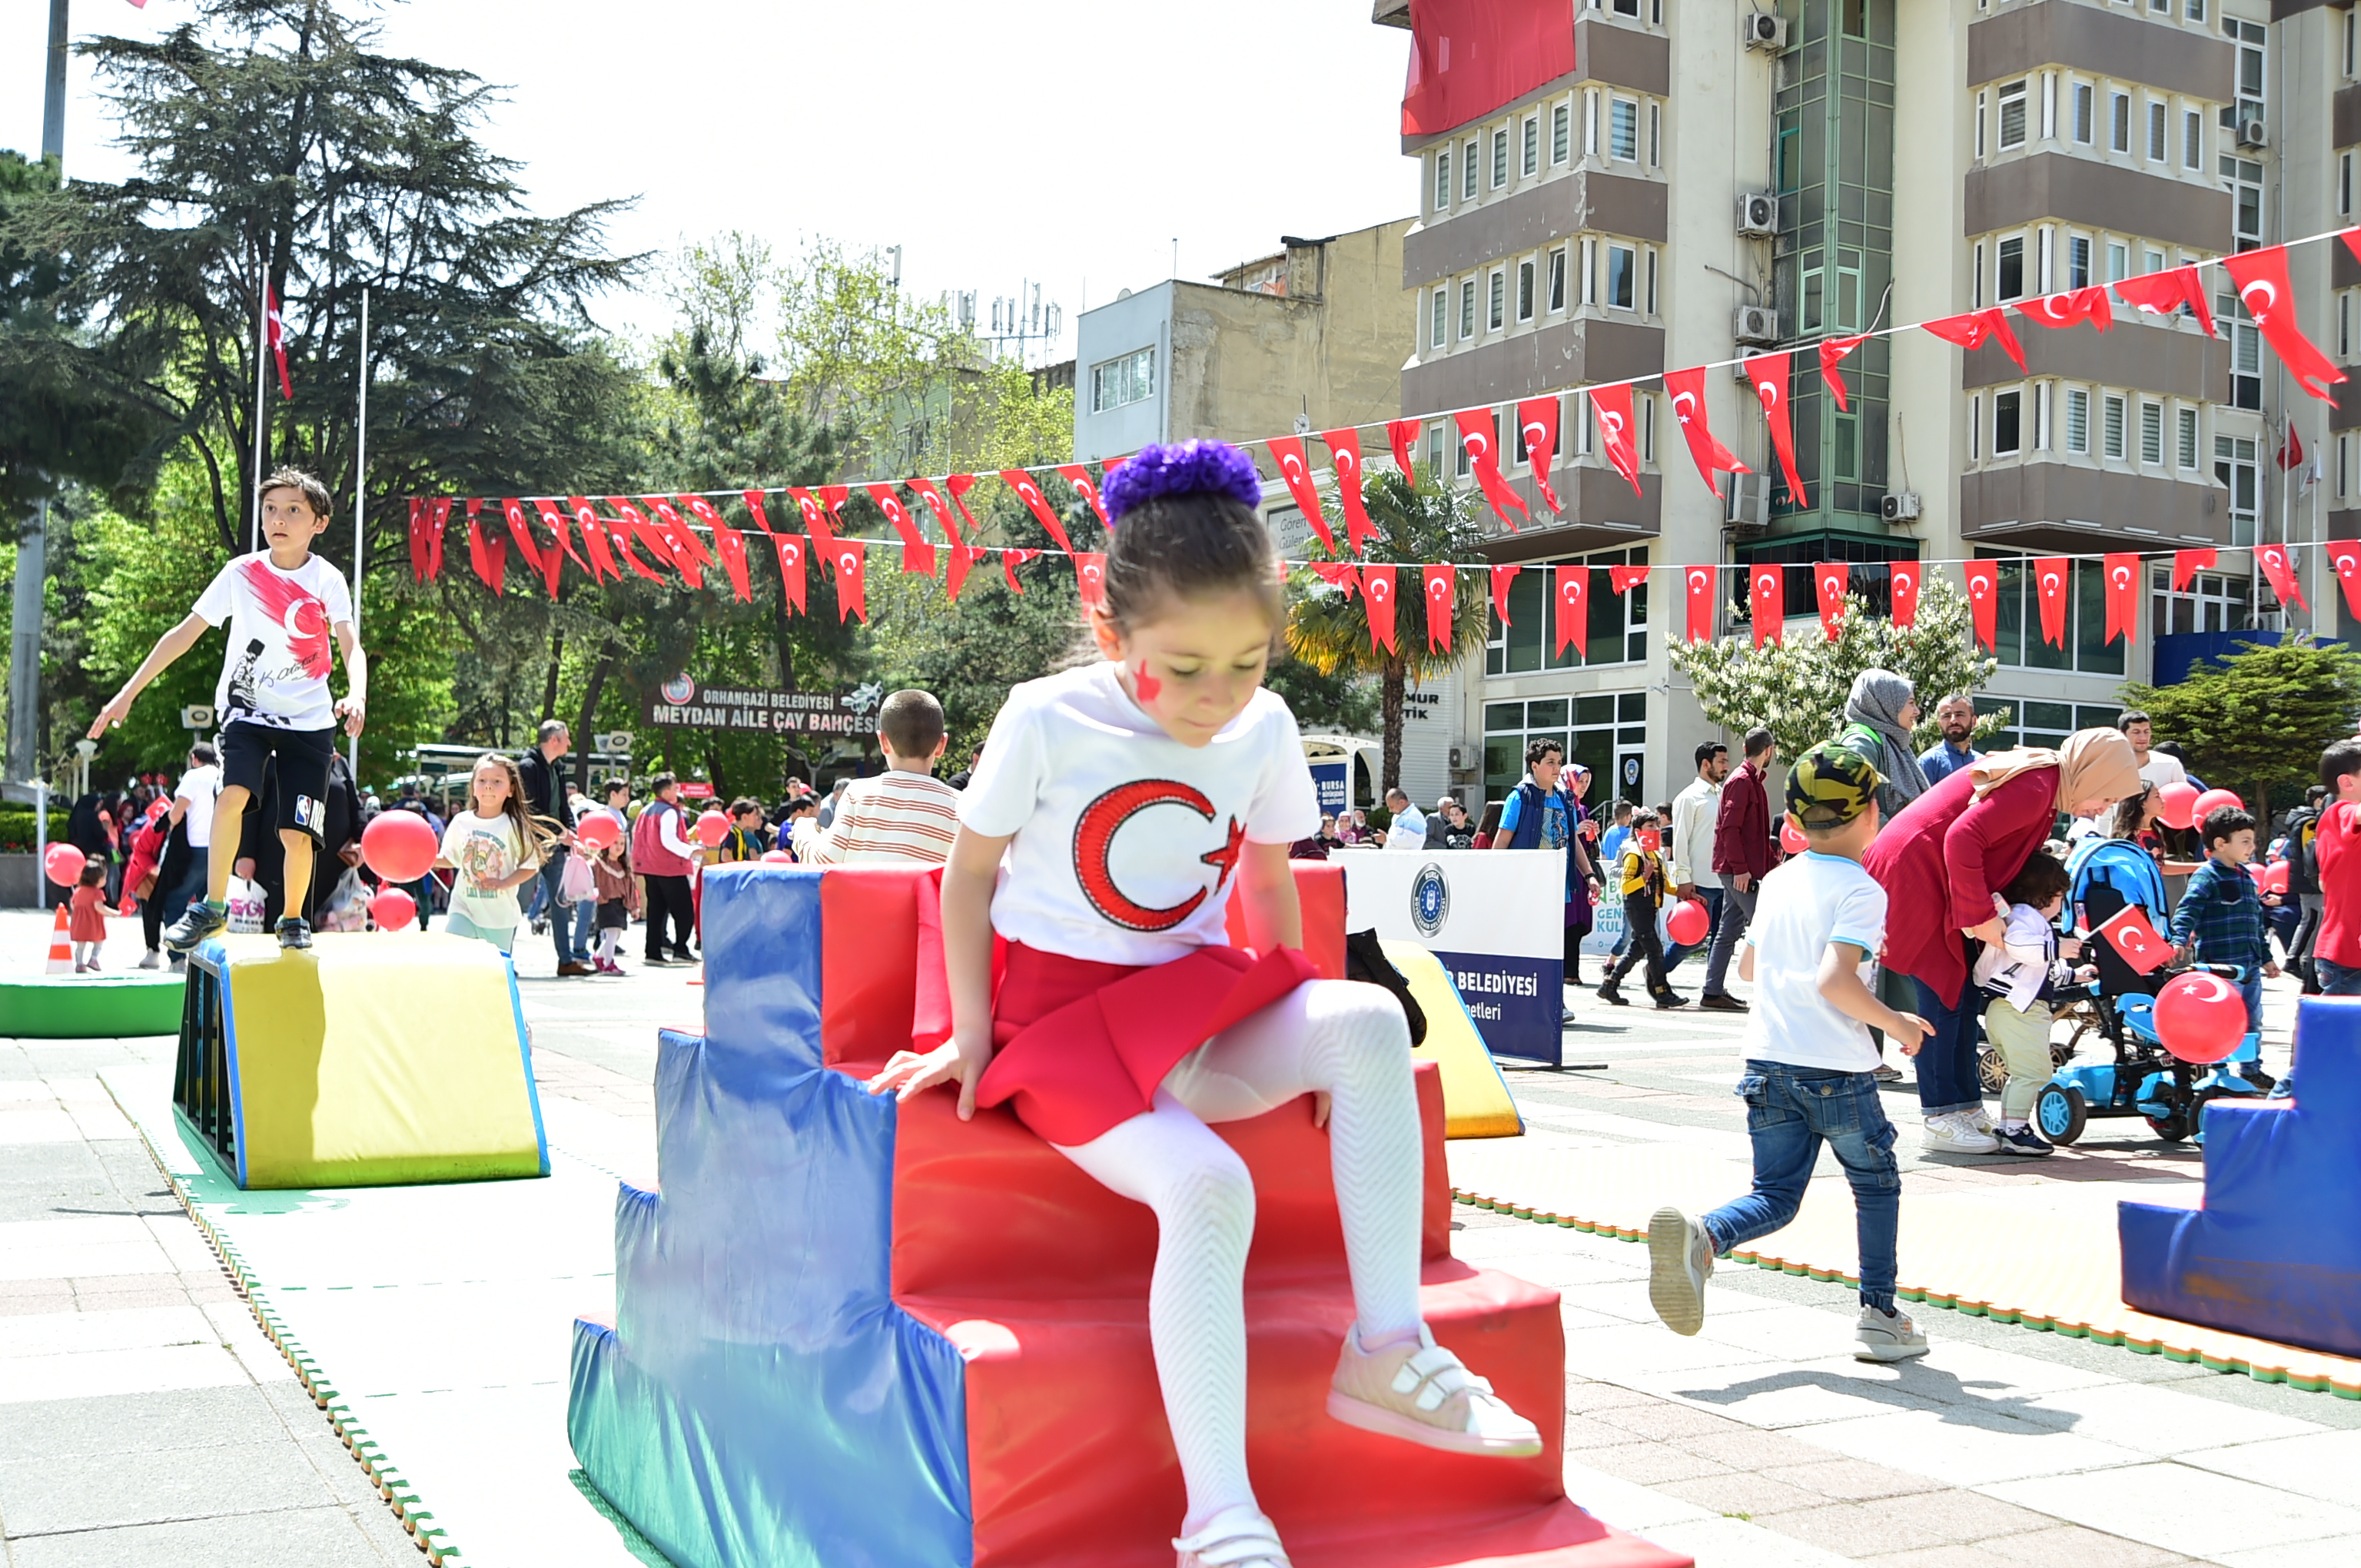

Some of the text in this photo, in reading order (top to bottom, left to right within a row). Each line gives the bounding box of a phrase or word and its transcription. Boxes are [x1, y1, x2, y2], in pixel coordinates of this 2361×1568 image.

[1280, 517, 1307, 532] Gören
[1279, 534, 1304, 550] Gülen
[702, 689, 834, 710] ORHANGAZİ BELEDİYESİ
[653, 704, 878, 736] MEYDAN AİLE ÇAY BAHÇESİ
[1321, 780, 1345, 791] BURSA
[1597, 908, 1622, 919] GEN
[1597, 921, 1622, 932] KUL
[1458, 970, 1537, 997] BELEDİYESİ
